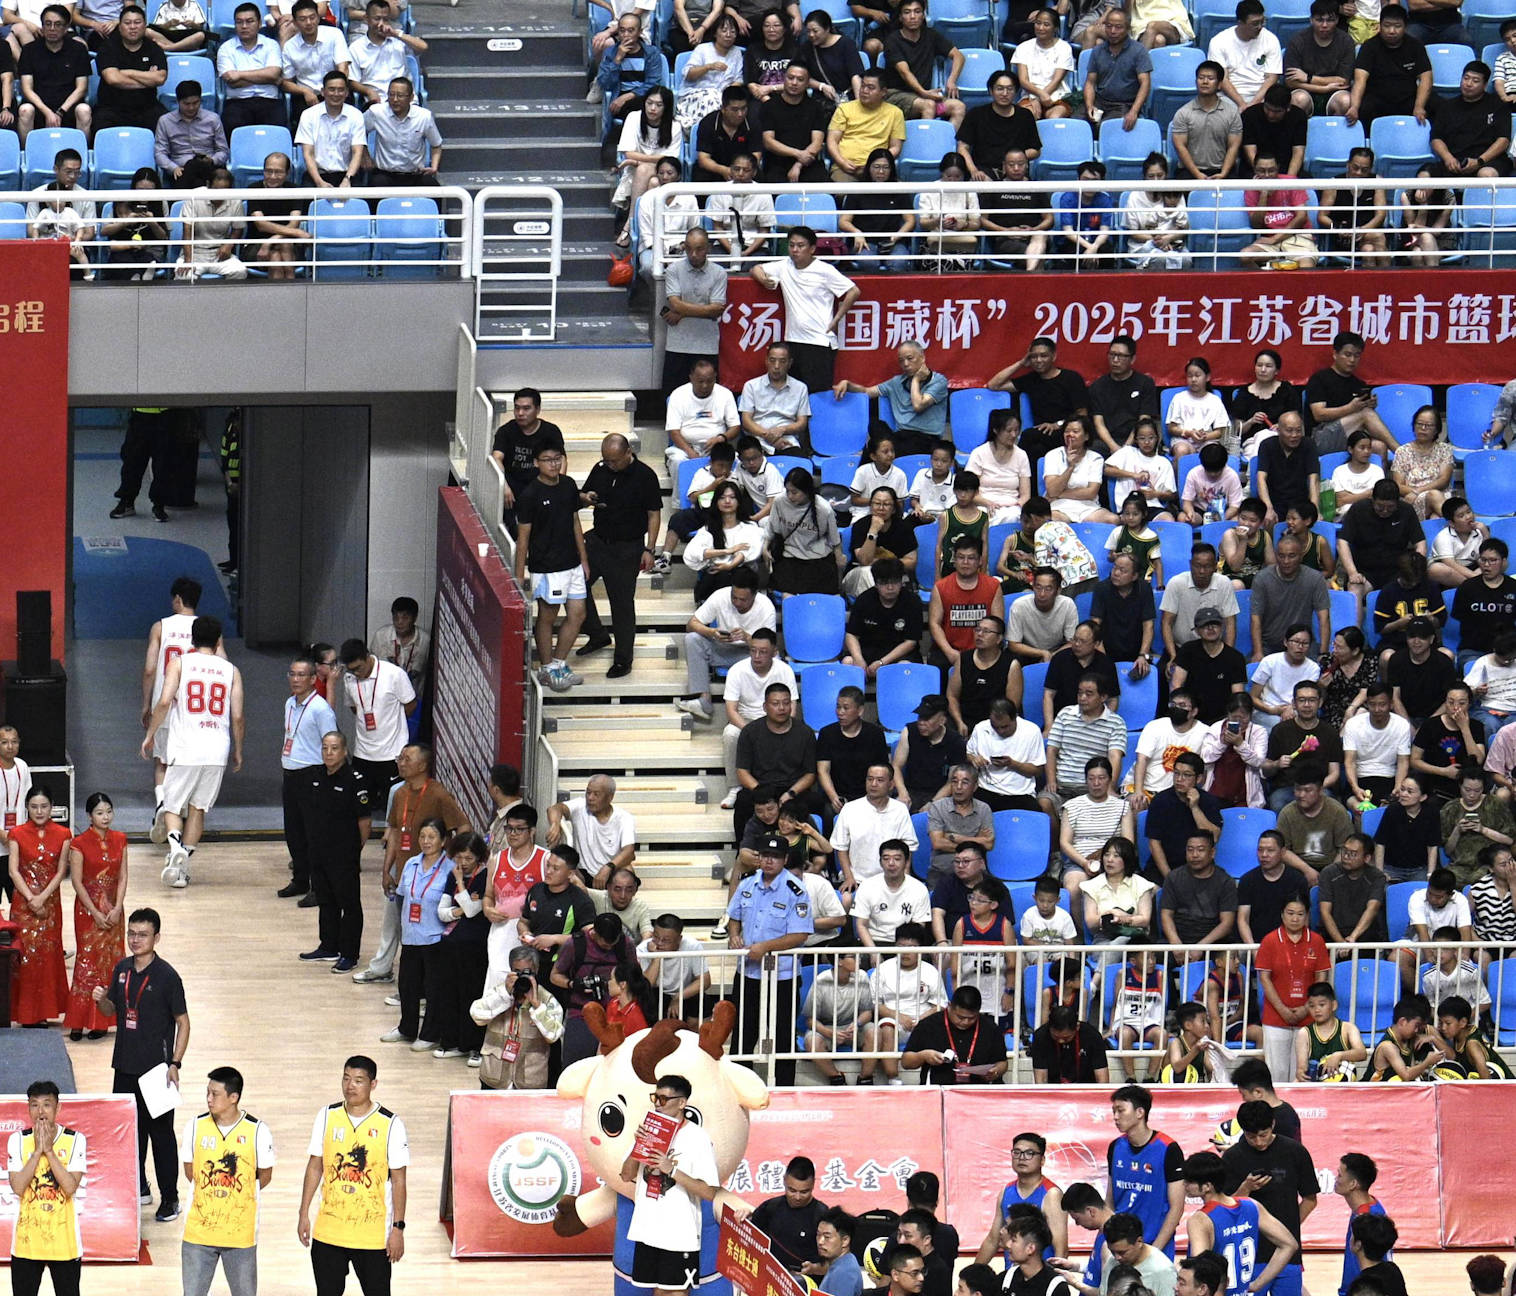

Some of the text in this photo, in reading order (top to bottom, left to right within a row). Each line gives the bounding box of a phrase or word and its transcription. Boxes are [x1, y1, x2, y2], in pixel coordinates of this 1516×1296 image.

[724, 292, 1007, 351] “汤国藏杯”
[187, 680, 228, 716] 88
[200, 1135, 216, 1150] 44
[1223, 1237, 1256, 1290] 19
